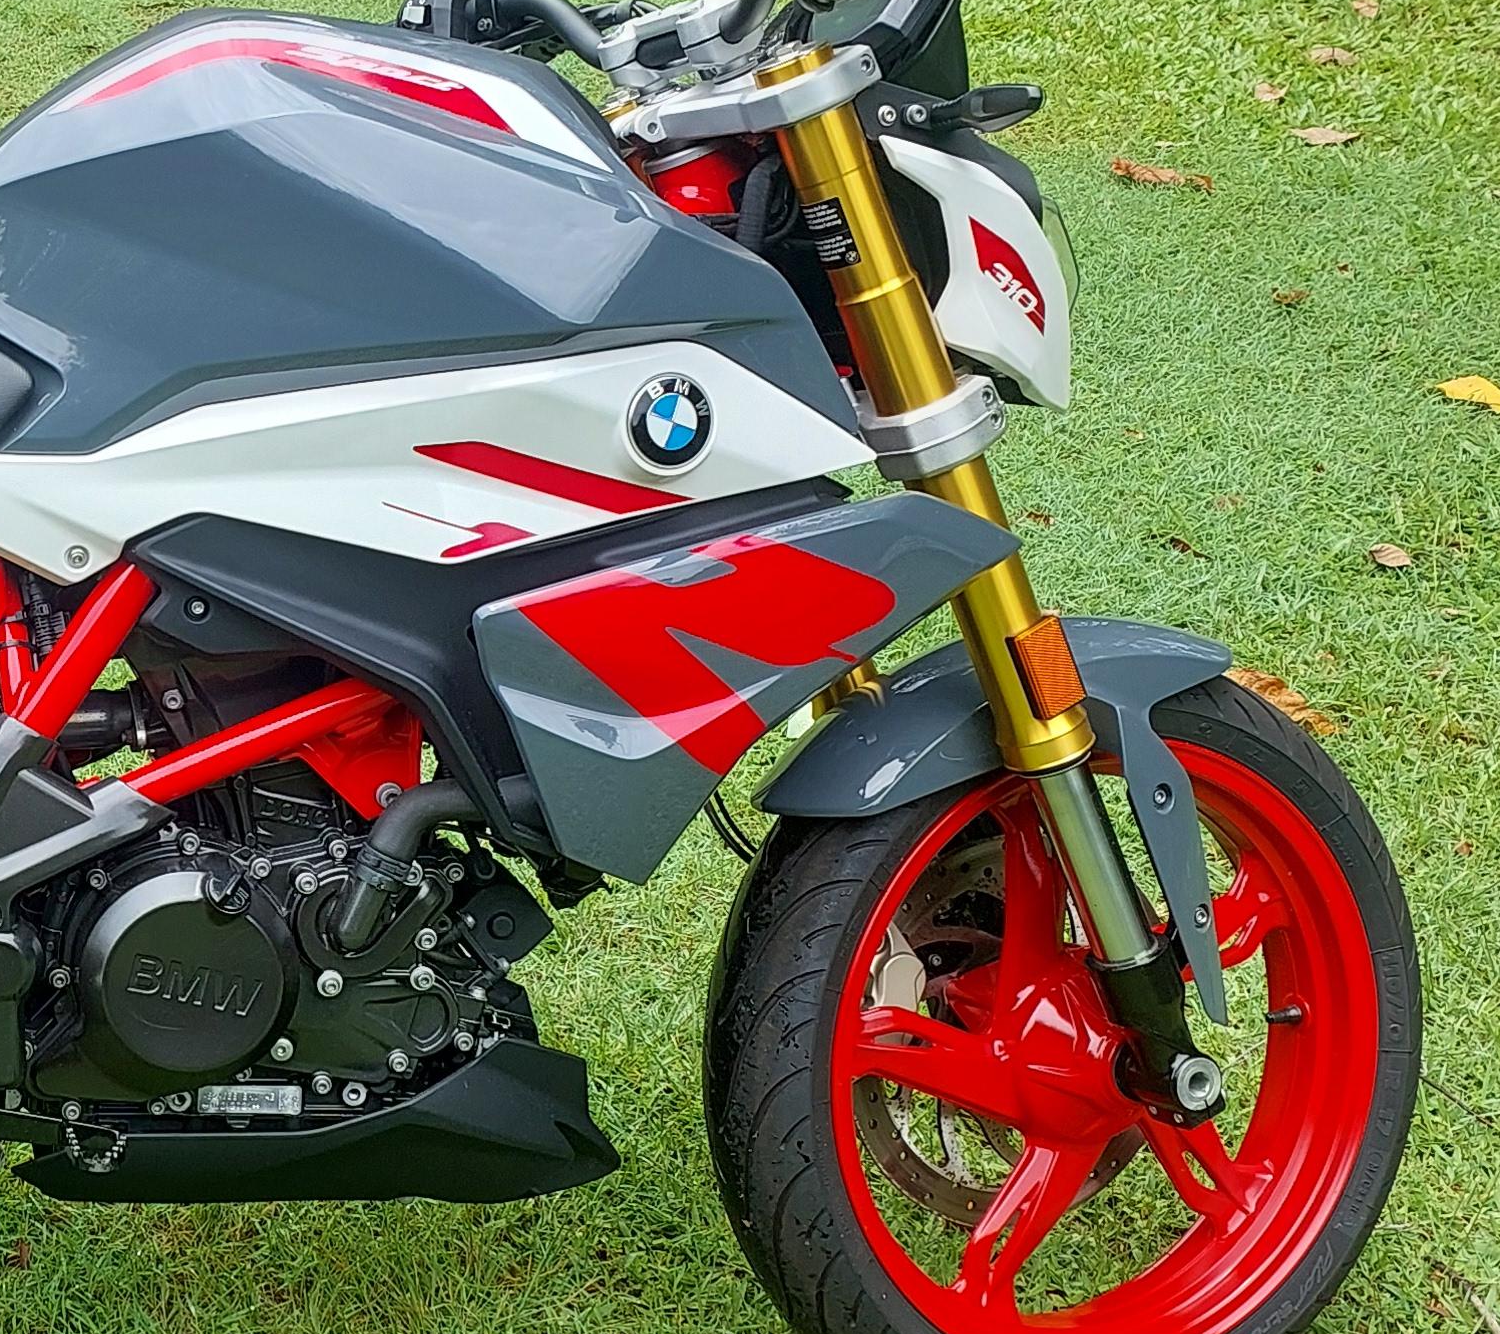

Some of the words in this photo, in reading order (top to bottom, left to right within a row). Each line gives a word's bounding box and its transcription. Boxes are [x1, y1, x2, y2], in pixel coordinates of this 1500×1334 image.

[983, 262, 1039, 314] 310
[646, 377, 710, 418] BMW
[260, 798, 330, 830] DOHC
[126, 952, 265, 1017] BMW
